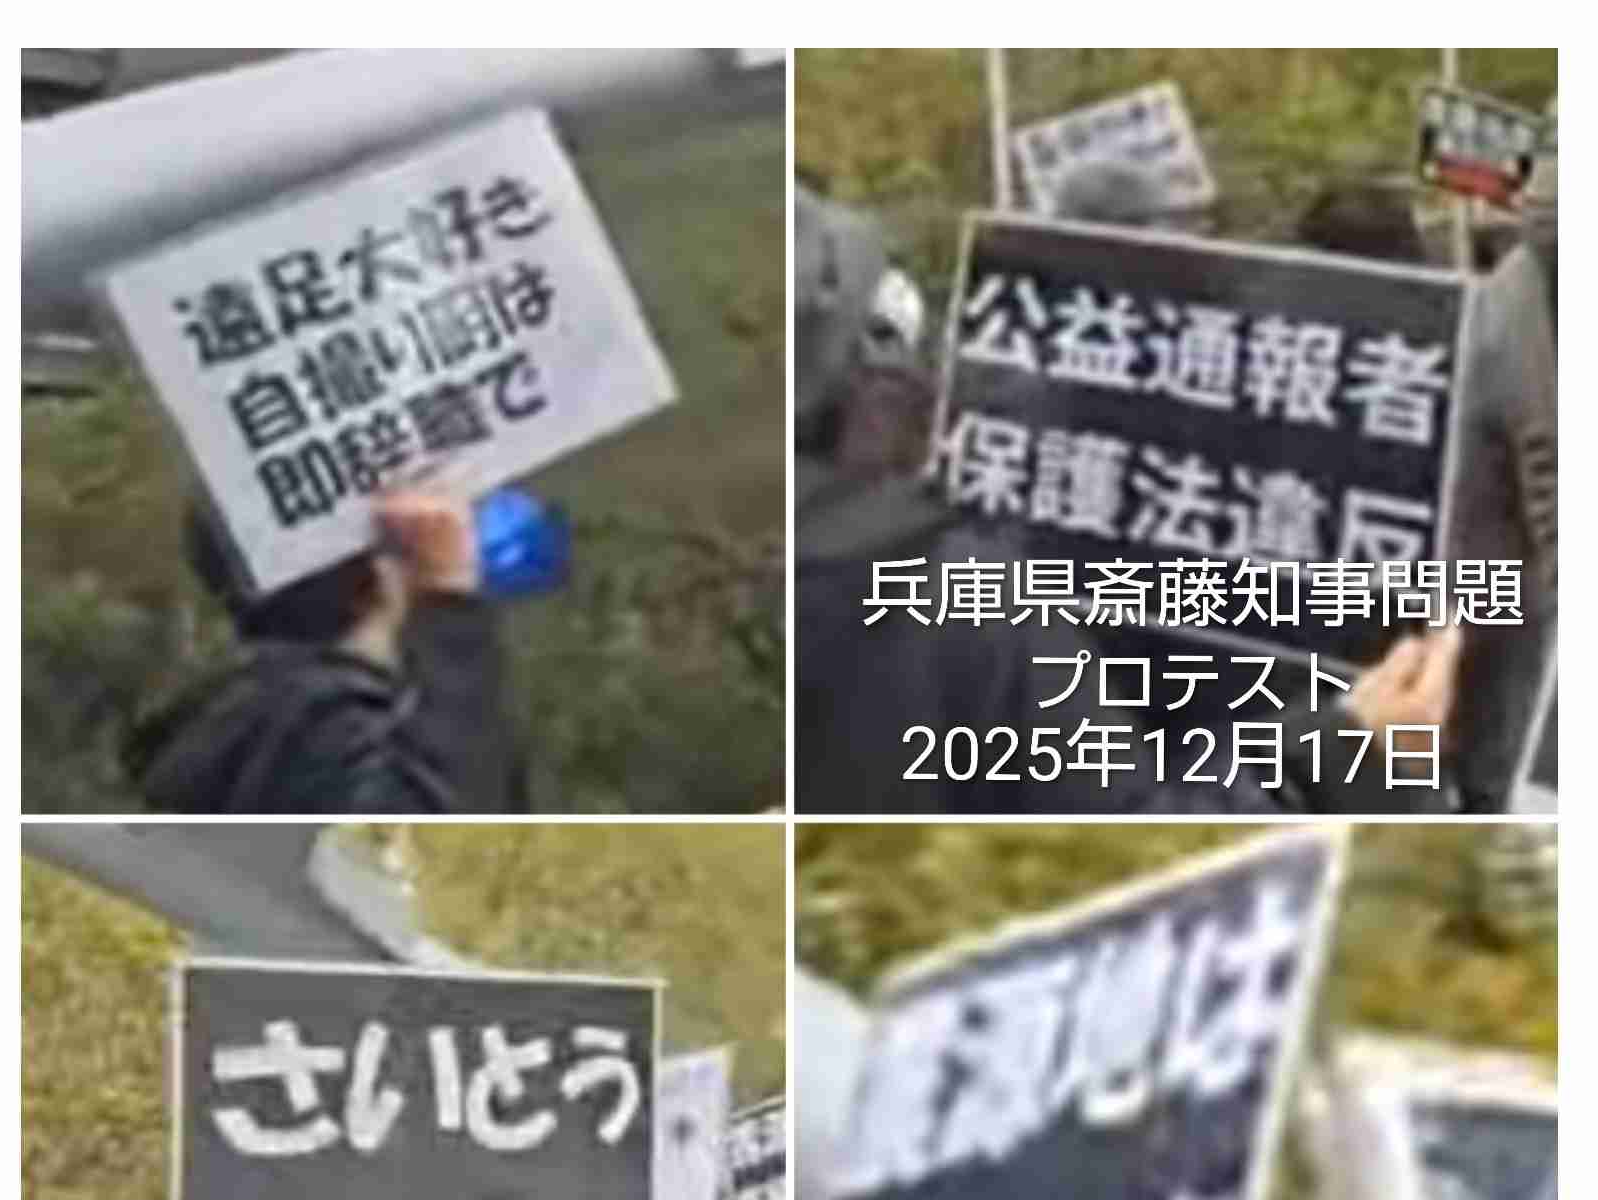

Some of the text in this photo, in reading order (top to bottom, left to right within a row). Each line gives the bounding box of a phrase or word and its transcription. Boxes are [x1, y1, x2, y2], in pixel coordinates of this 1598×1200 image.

[172, 173, 554, 367] 遠足大好き
[958, 274, 1449, 446] 公益通報者
[943, 411, 1434, 588] 保護法違反
[212, 1018, 640, 1157] さいとう
